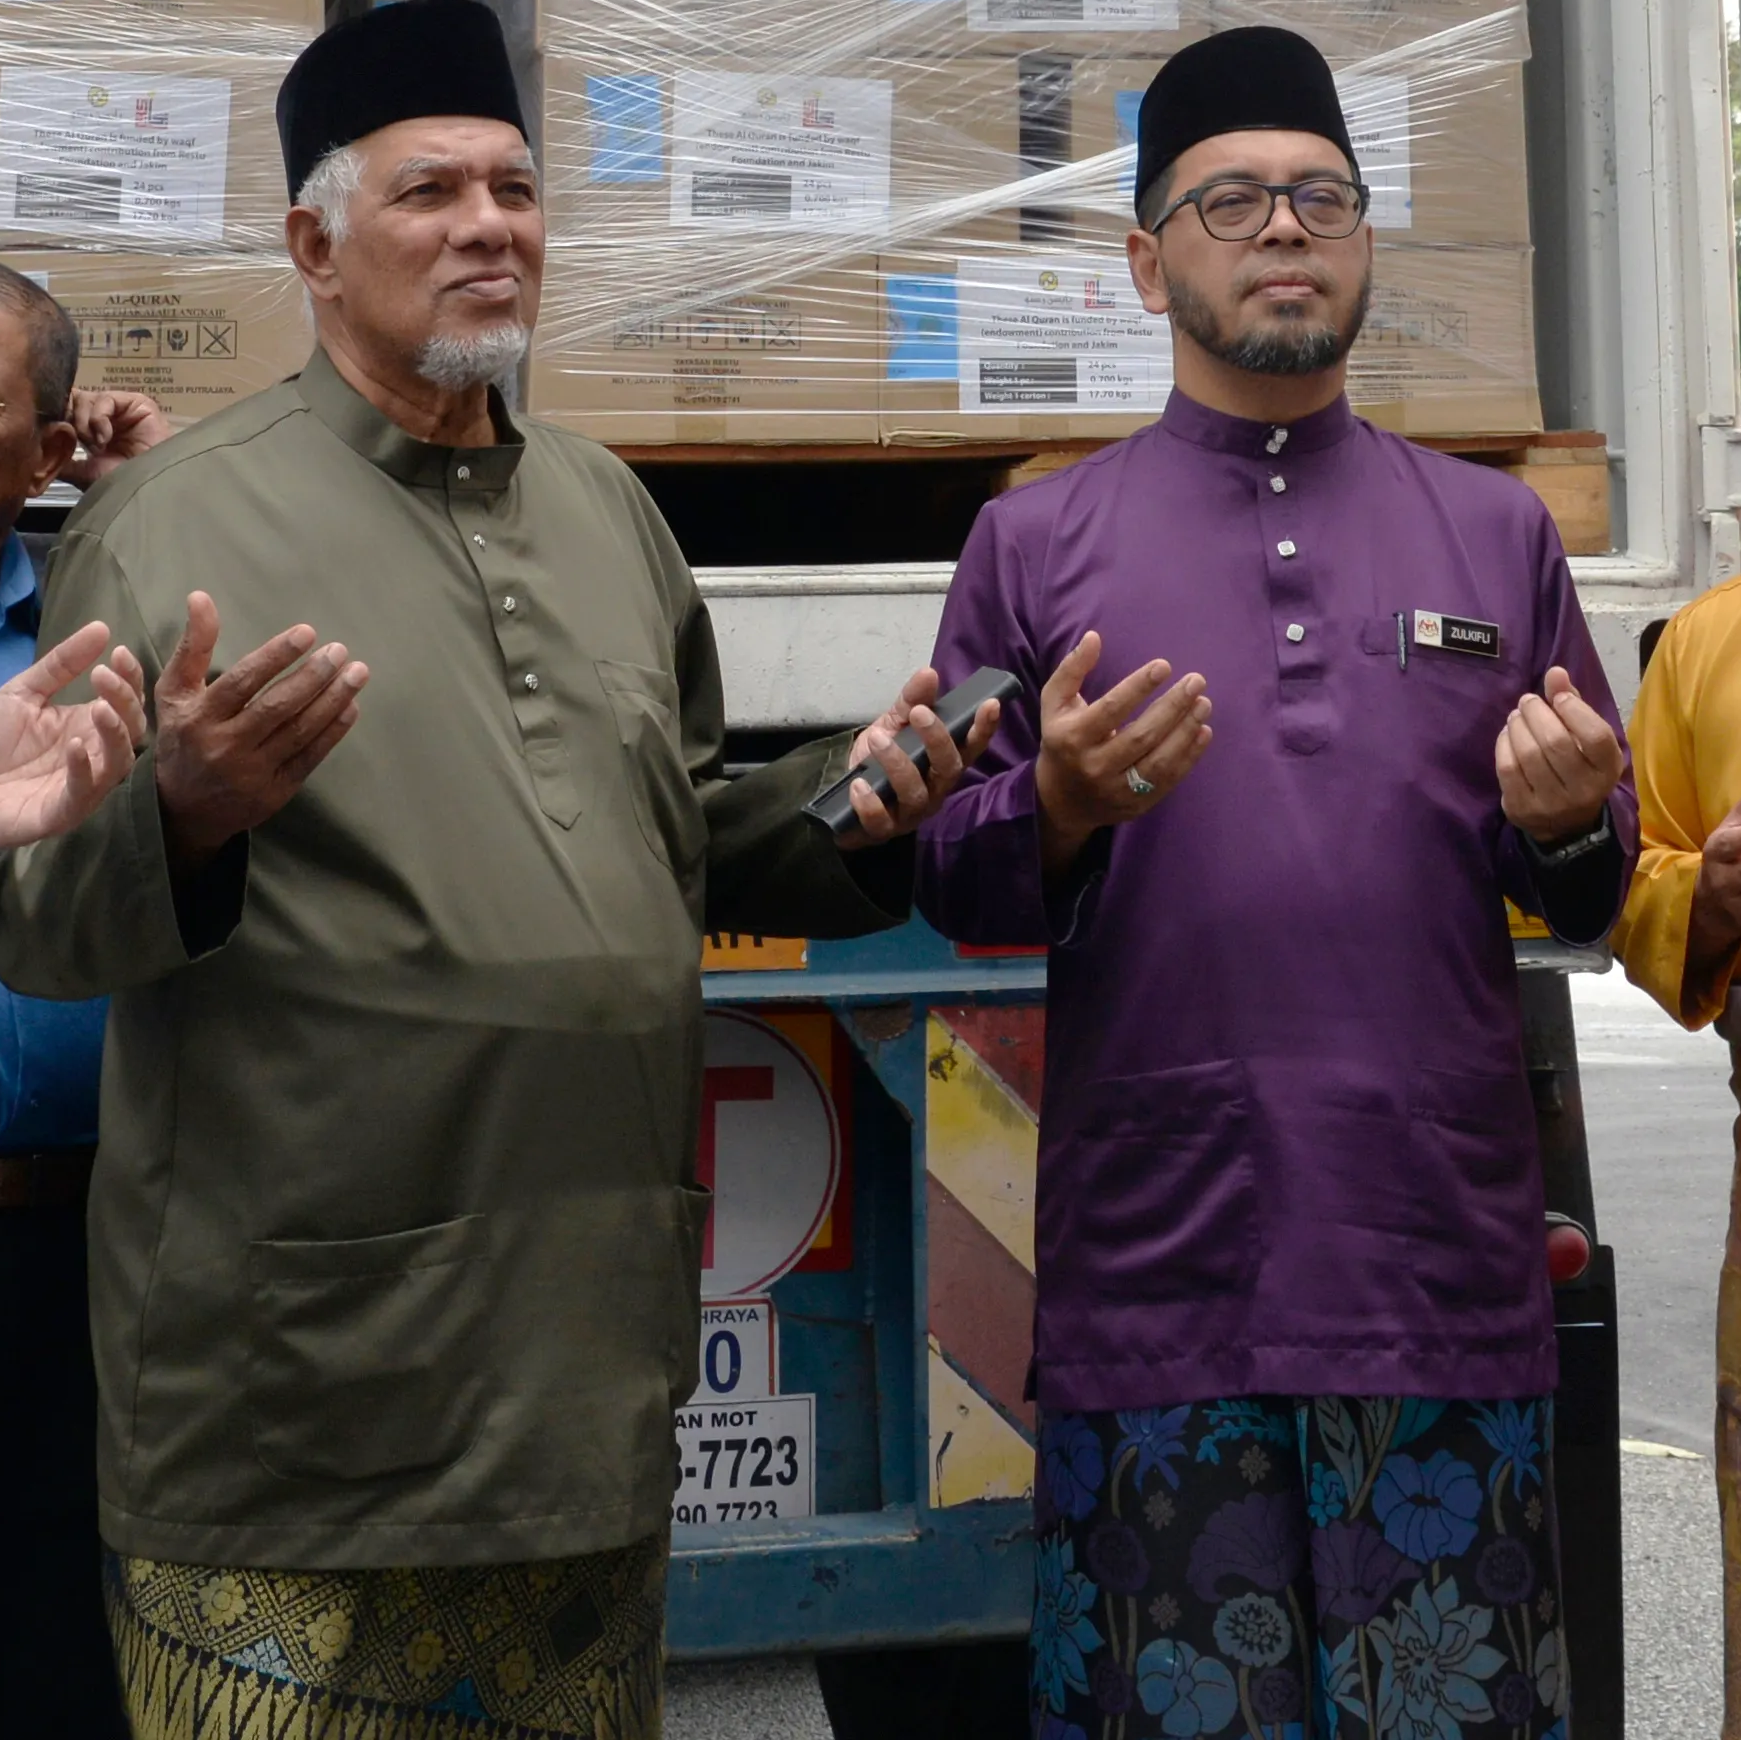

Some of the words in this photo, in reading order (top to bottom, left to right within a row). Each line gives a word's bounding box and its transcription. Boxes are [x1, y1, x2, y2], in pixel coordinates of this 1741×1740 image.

[105, 294, 182, 305] AL-QURAN
[1032, 315, 1059, 323] Quran
[1072, 340, 1088, 348] and
[1091, 340, 1117, 348] Jakim
[1450, 626, 1490, 644] ZULKIFLI
[710, 1410, 759, 1428] MOT
